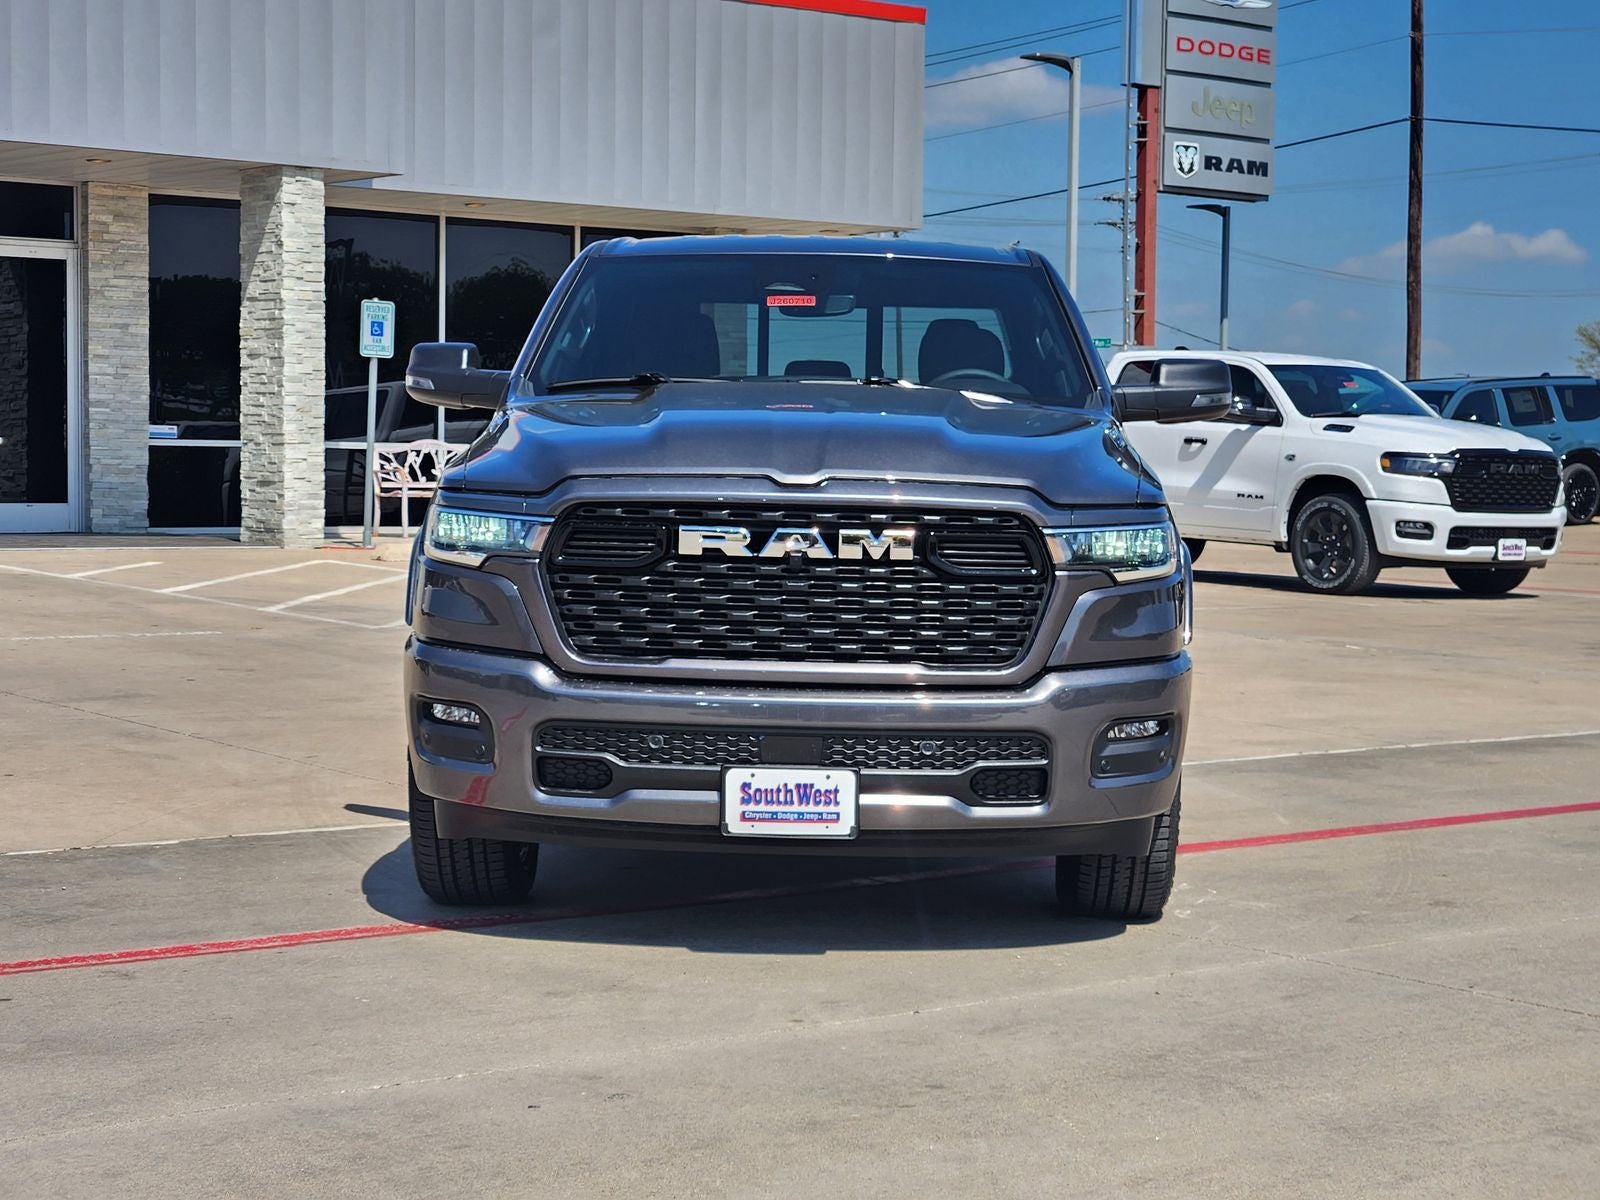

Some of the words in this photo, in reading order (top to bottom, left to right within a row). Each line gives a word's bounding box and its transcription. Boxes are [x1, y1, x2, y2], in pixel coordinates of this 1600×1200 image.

[1176, 36, 1271, 65] DODGE
[1191, 85, 1256, 129] Jeep
[1204, 155, 1269, 177] RAM
[1490, 463, 1540, 474] RAM
[678, 525, 916, 561] RAM
[745, 811, 772, 820] Chrysler
[777, 812, 798, 821] Dodge
[803, 812, 818, 821] Jeep
